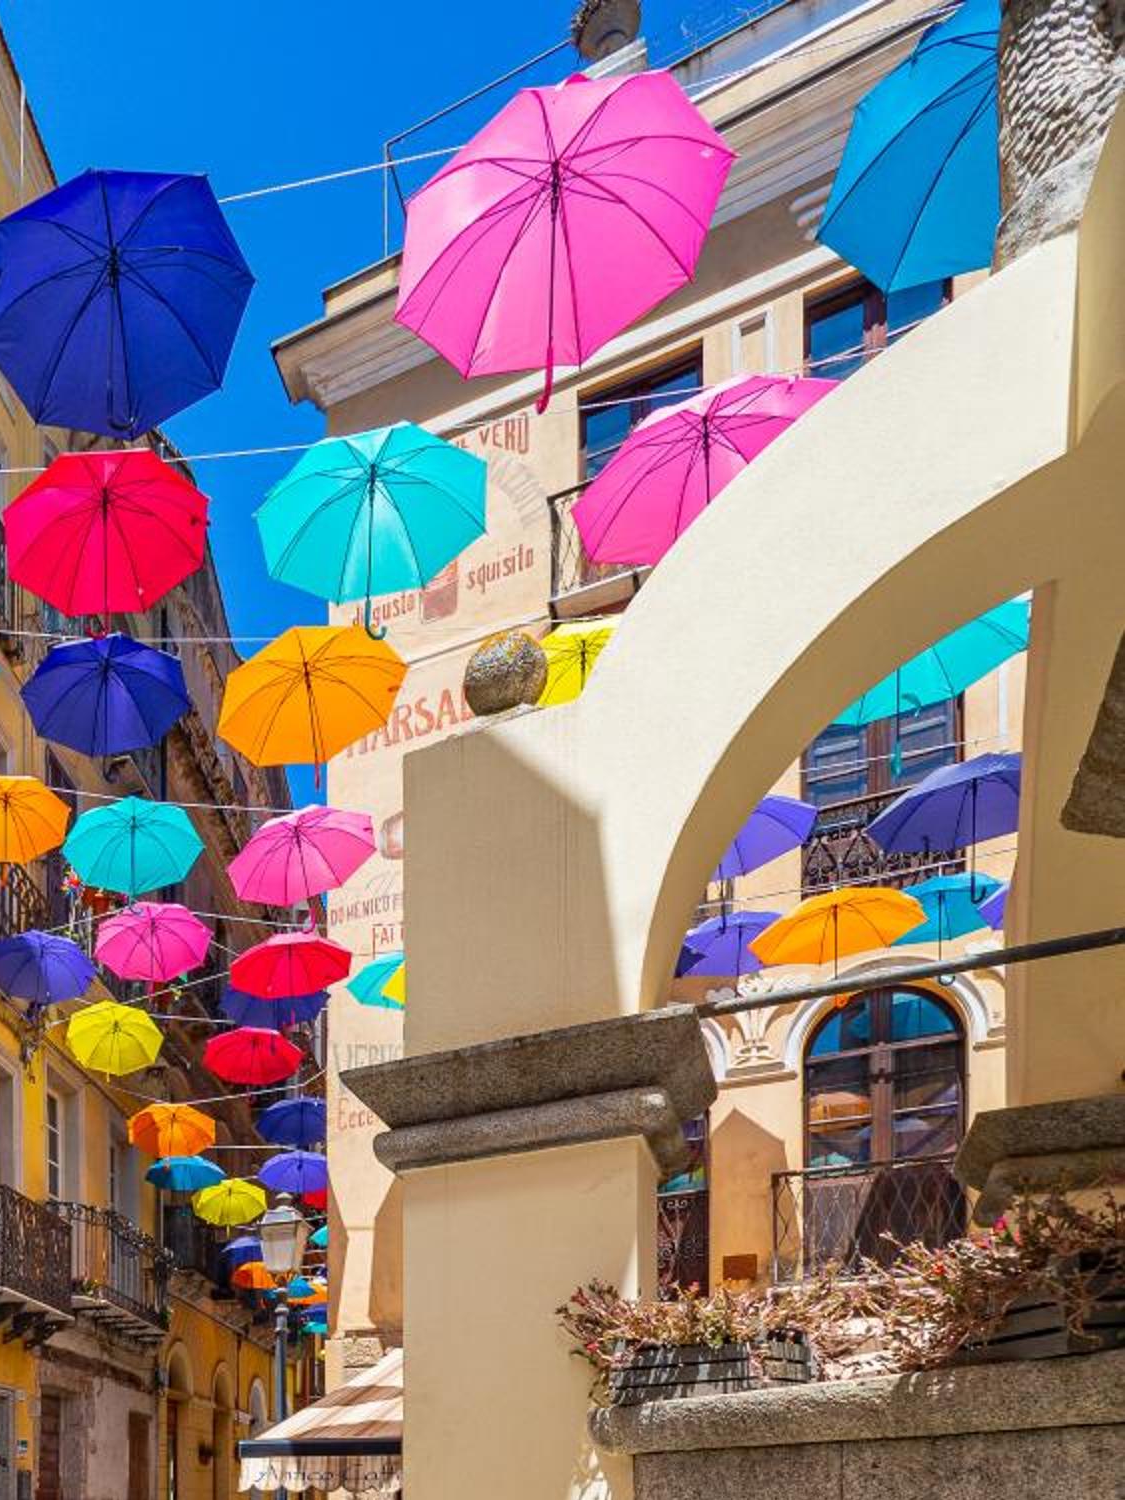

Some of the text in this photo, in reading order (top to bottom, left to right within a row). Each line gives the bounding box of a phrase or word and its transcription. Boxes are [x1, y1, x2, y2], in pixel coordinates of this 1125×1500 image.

[372, 590, 414, 627] gusto
[466, 543, 535, 593] squisito
[337, 1097, 373, 1131] Ecce
